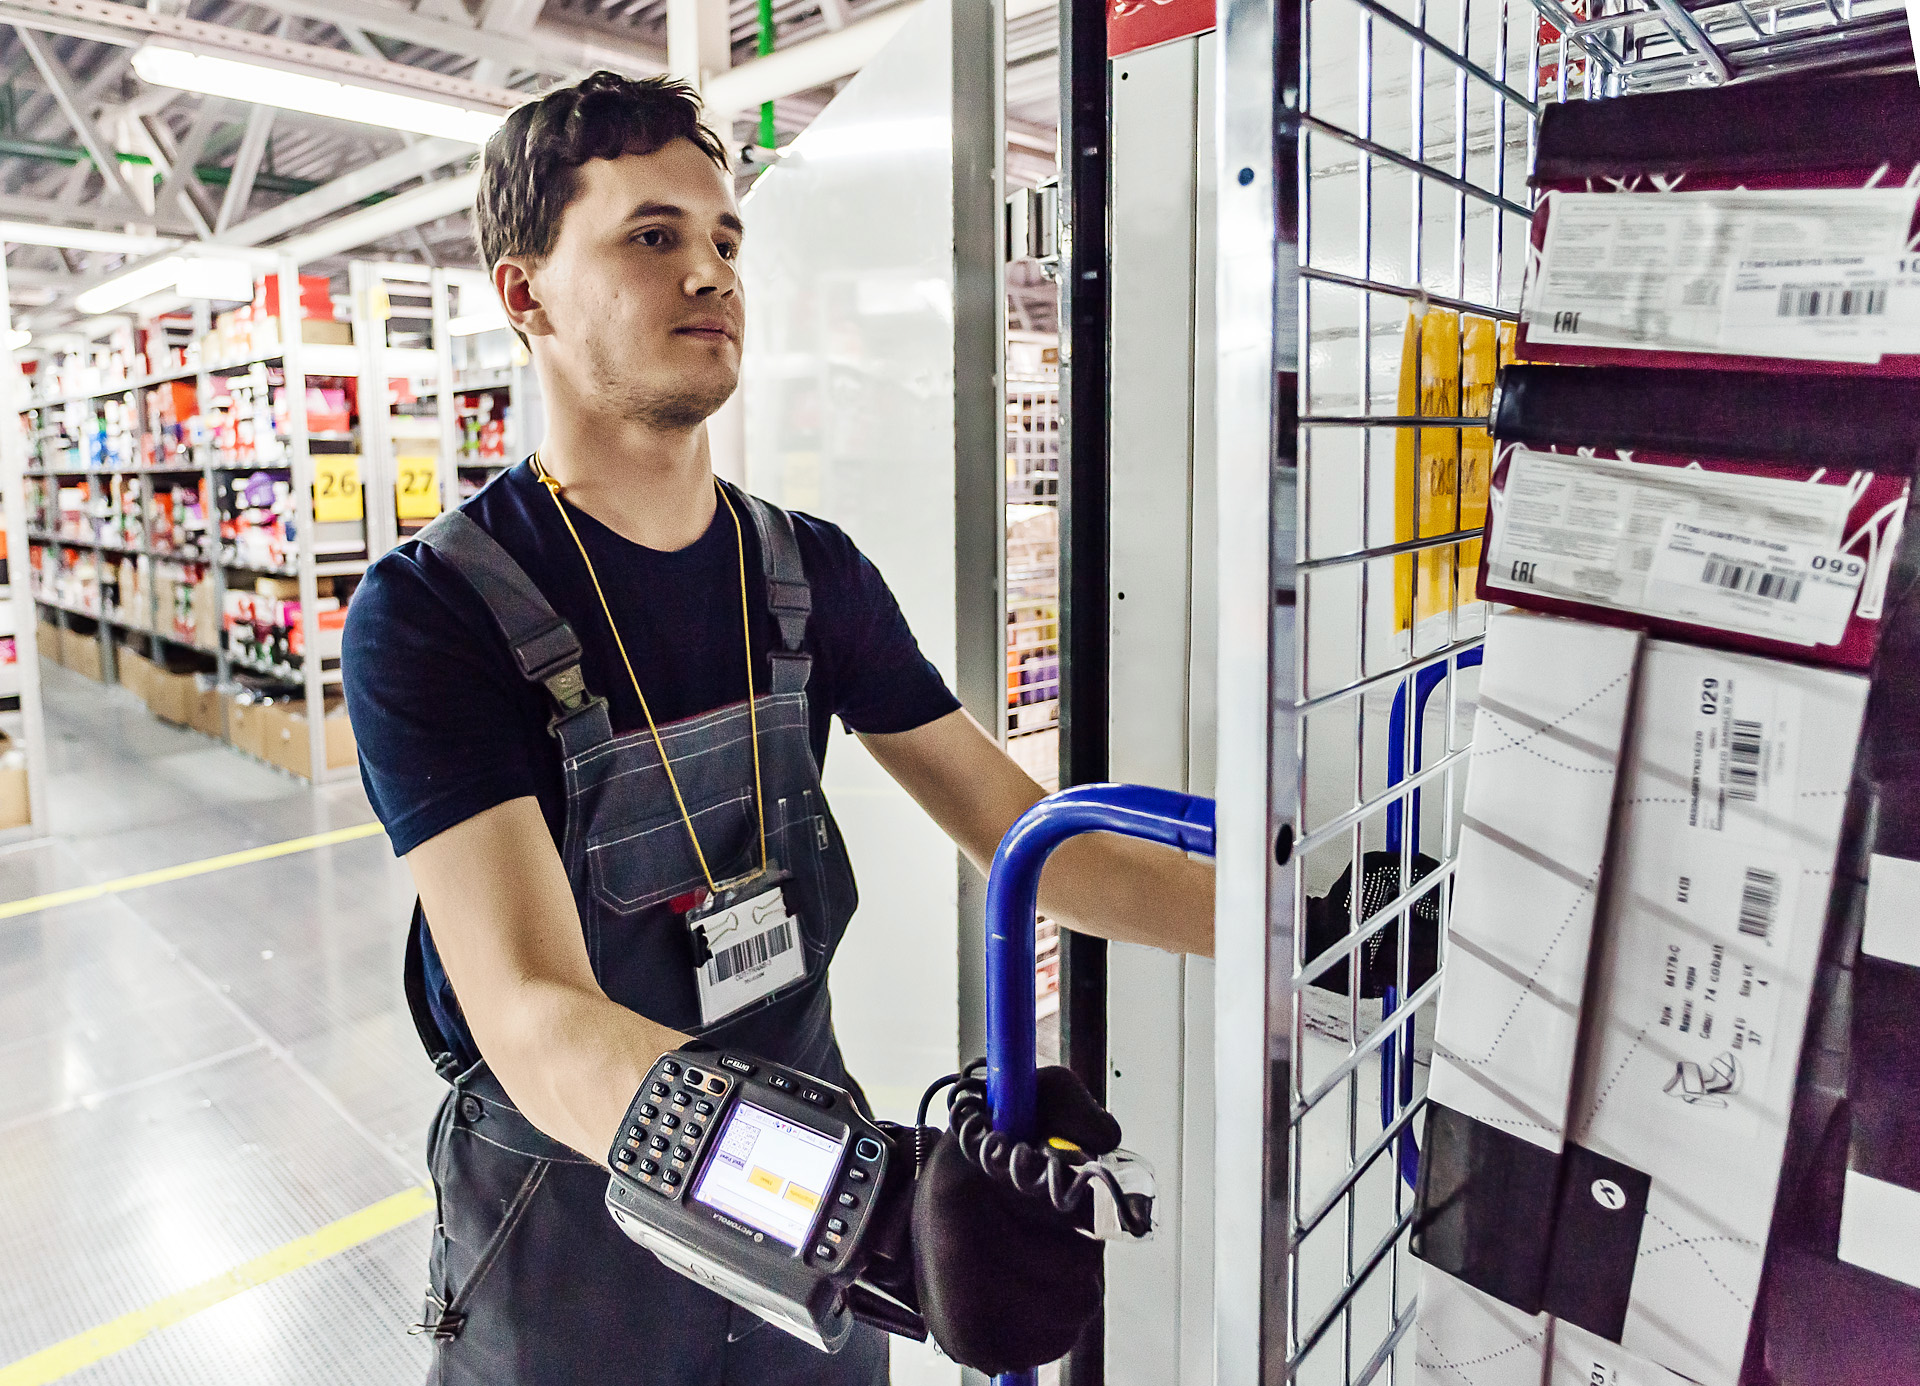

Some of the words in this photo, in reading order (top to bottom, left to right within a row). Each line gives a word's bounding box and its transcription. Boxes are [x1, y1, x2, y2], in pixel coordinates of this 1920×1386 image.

[320, 470, 356, 497] 26
[401, 469, 433, 495] 27
[1811, 555, 1861, 578] 099
[1701, 678, 1719, 715] 029
[1710, 944, 1724, 983] cobalt
[1743, 963, 1755, 977] UK
[1705, 988, 1717, 1002] 74
[1739, 980, 1752, 997] Size
[1732, 1033, 1744, 1050] Size
[1748, 1030, 1762, 1046] 37
[713, 1213, 754, 1237] MOTOROLA
